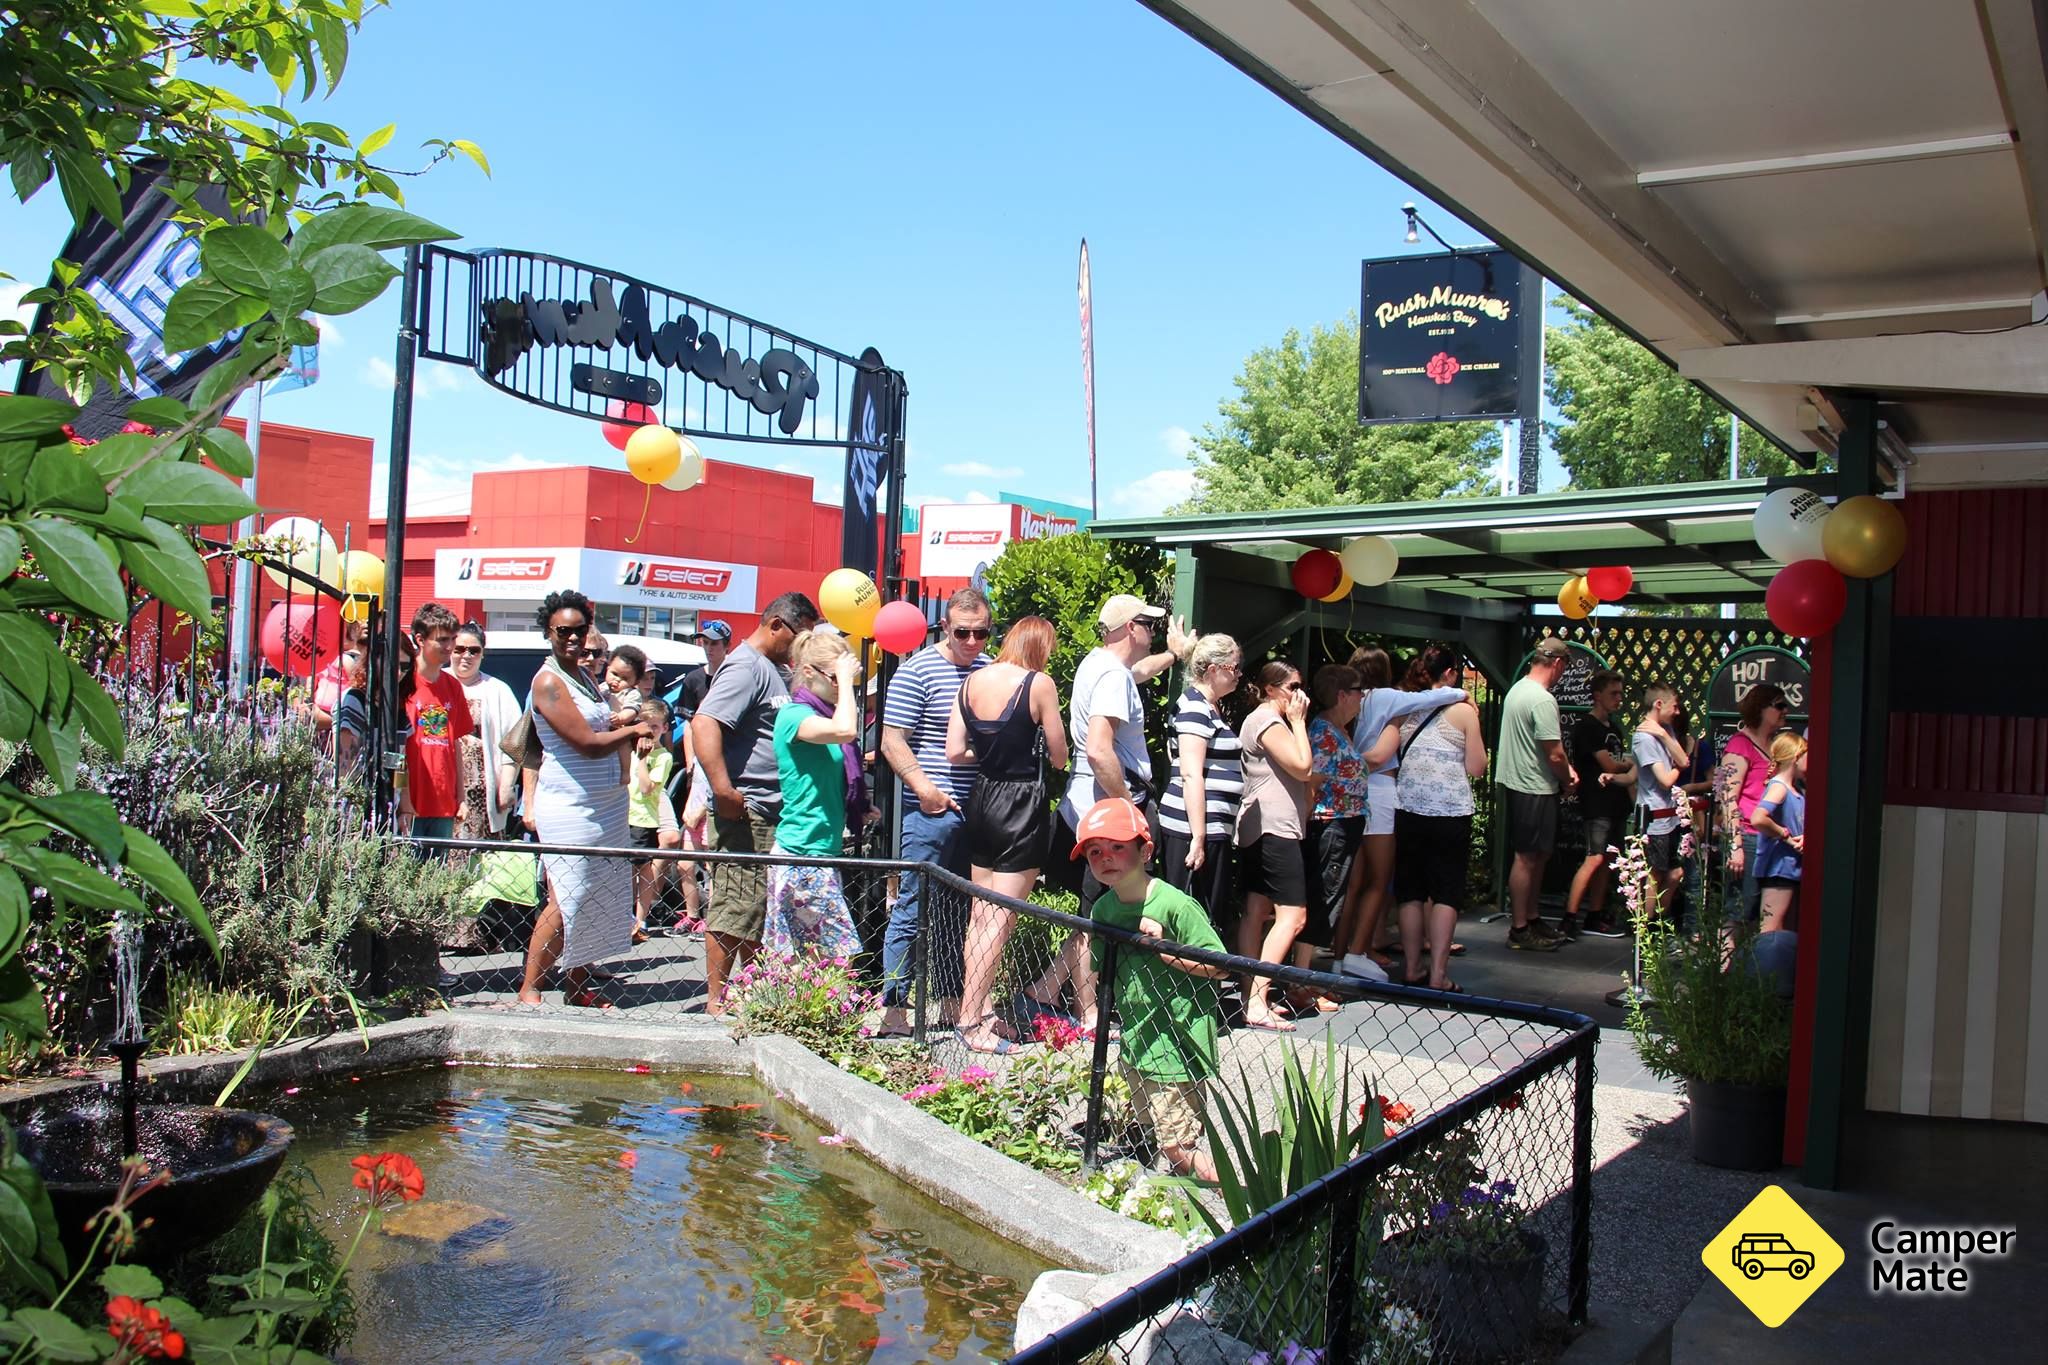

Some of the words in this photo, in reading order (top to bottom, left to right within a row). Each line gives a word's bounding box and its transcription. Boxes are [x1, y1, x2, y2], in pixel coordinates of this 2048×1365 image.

[1375, 293, 1430, 329] Rush
[1407, 311, 1451, 329] Hawke's
[1452, 310, 1479, 328] Bay
[1395, 367, 1426, 375] NATURAL
[1473, 362, 1500, 370] CREAM
[482, 559, 549, 577] select
[653, 568, 724, 587] select
[639, 588, 658, 598] TYRE
[659, 590, 665, 598] &
[667, 591, 688, 600] AUTO
[688, 592, 719, 602] SERVICE
[1732, 658, 1776, 682] HOT
[1735, 682, 1804, 708] DKS
